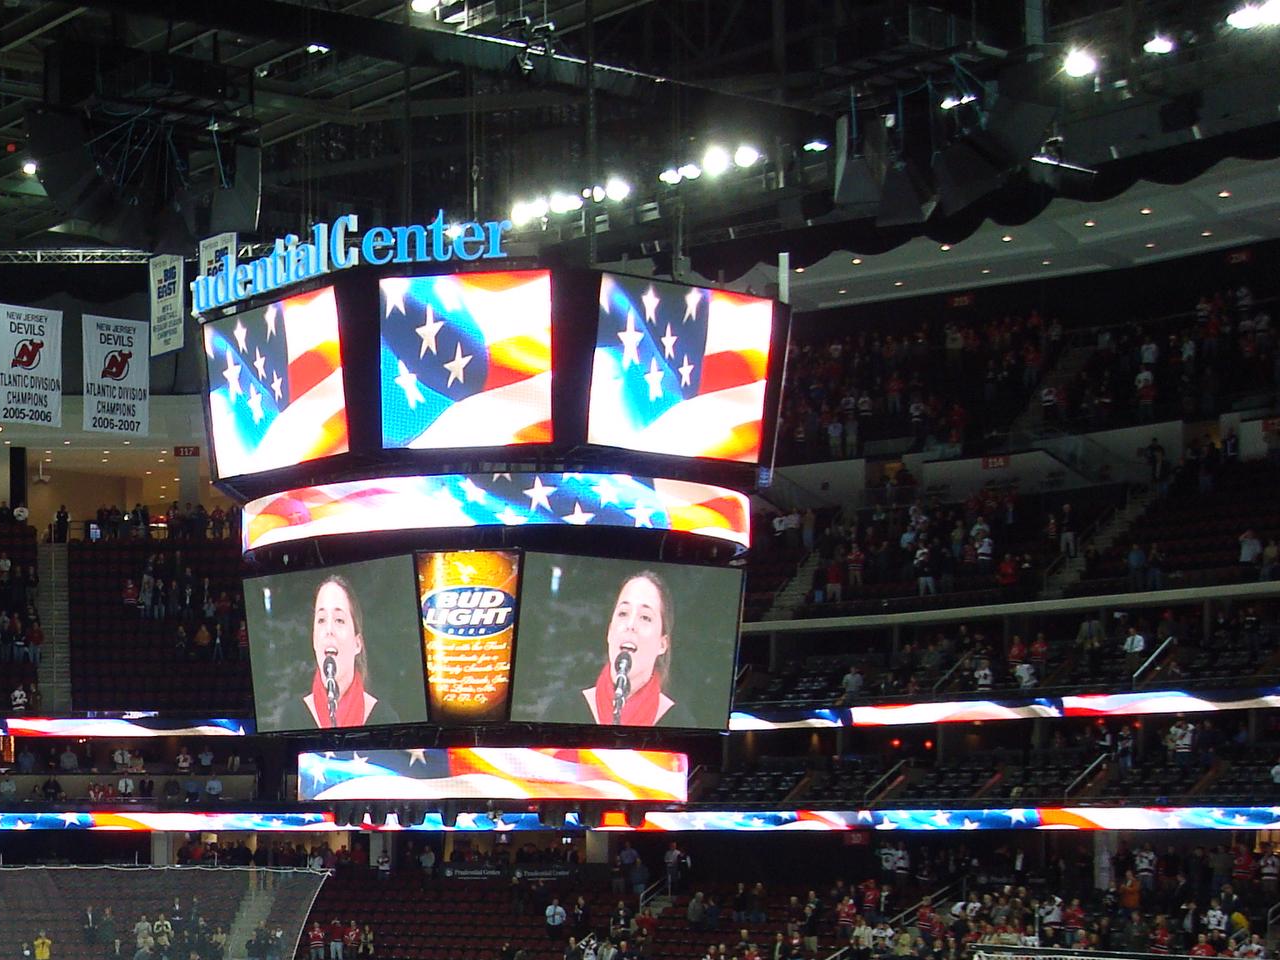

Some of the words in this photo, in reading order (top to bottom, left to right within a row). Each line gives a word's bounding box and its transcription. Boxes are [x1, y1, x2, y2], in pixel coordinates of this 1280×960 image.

[330, 208, 512, 270] Center
[157, 281, 176, 299] EAST
[6, 312, 22, 321] NEW
[24, 314, 48, 323] JERSEY
[9, 321, 45, 337] DEVILS
[96, 322, 112, 332] NEW
[114, 324, 136, 335] JERSEY
[100, 332, 133, 348] DEVILS
[29, 376, 61, 392] DIVISION
[86, 383, 116, 399] ATLANTIC
[118, 385, 147, 401] DIVISION
[7, 391, 48, 407] CHAMPIONS
[3, 407, 52, 423] 2005-2006
[97, 400, 136, 417] CHAMPIONS
[92, 417, 141, 432] 2006-2007
[179, 447, 194, 456] 117
[438, 591, 504, 608] BUD
[424, 607, 513, 626] LIGHT
